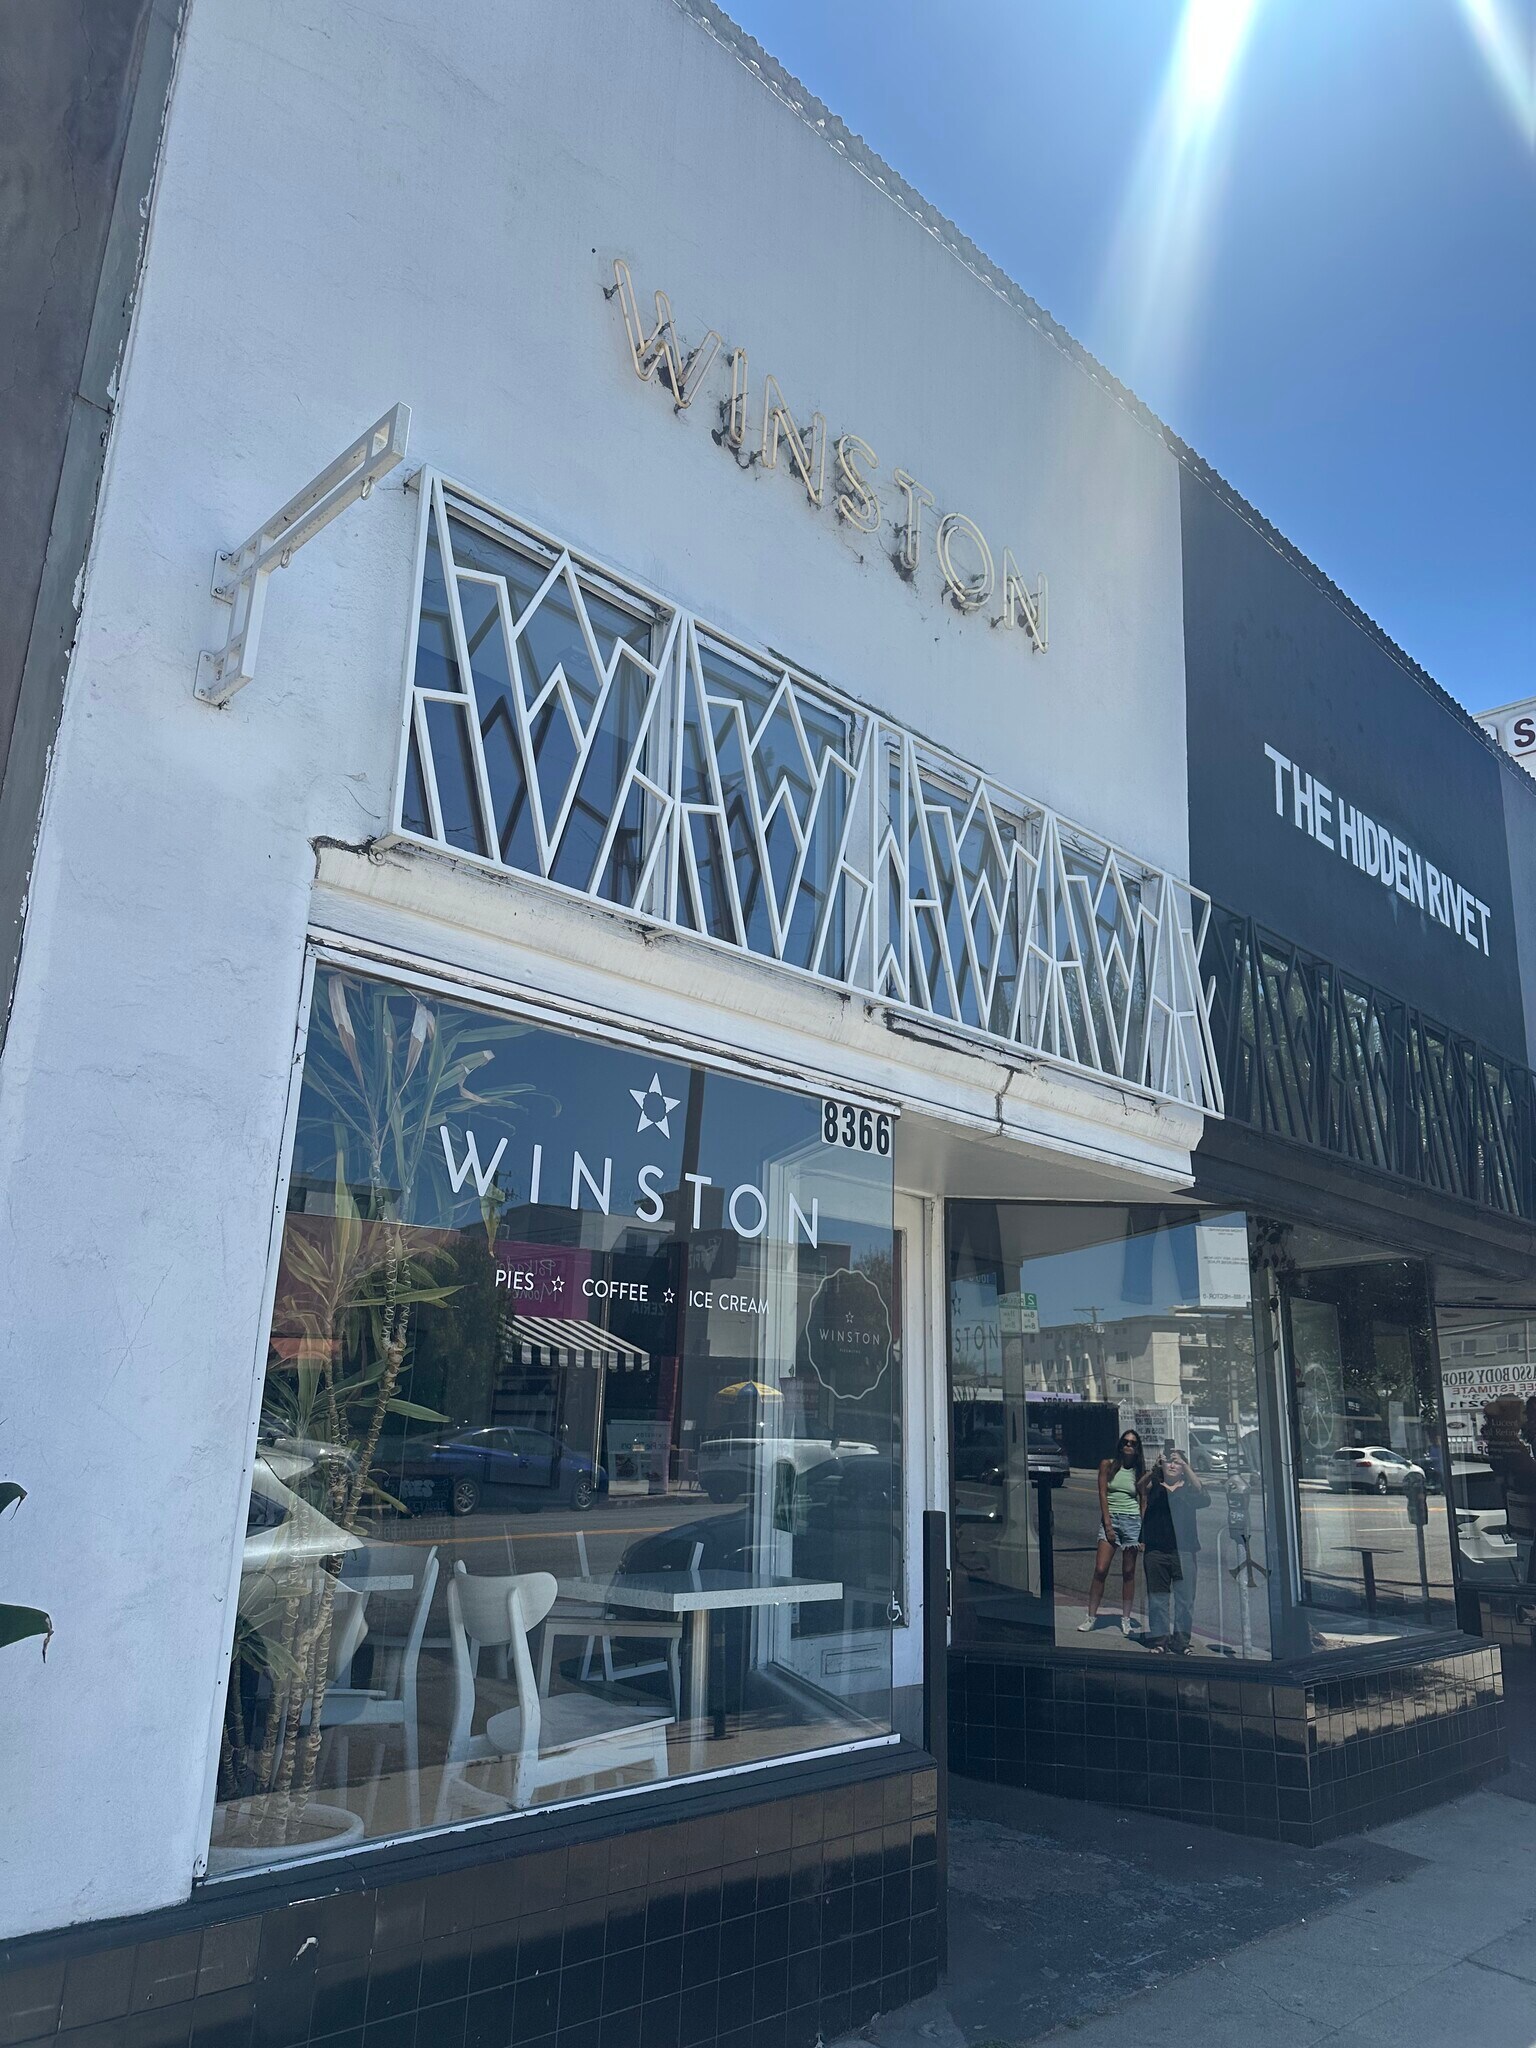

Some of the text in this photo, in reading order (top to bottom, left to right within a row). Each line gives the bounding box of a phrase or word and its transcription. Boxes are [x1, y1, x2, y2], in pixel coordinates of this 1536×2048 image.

[613, 258, 1049, 654] WINSTON
[1264, 742, 1491, 957] THE HIDDEN RIVET
[823, 1100, 890, 1156] 8366
[440, 1125, 818, 1250] WINSTON
[495, 1270, 770, 1315] PIES COFFEE ICE CREAM
[819, 1328, 880, 1345] WINSTON
